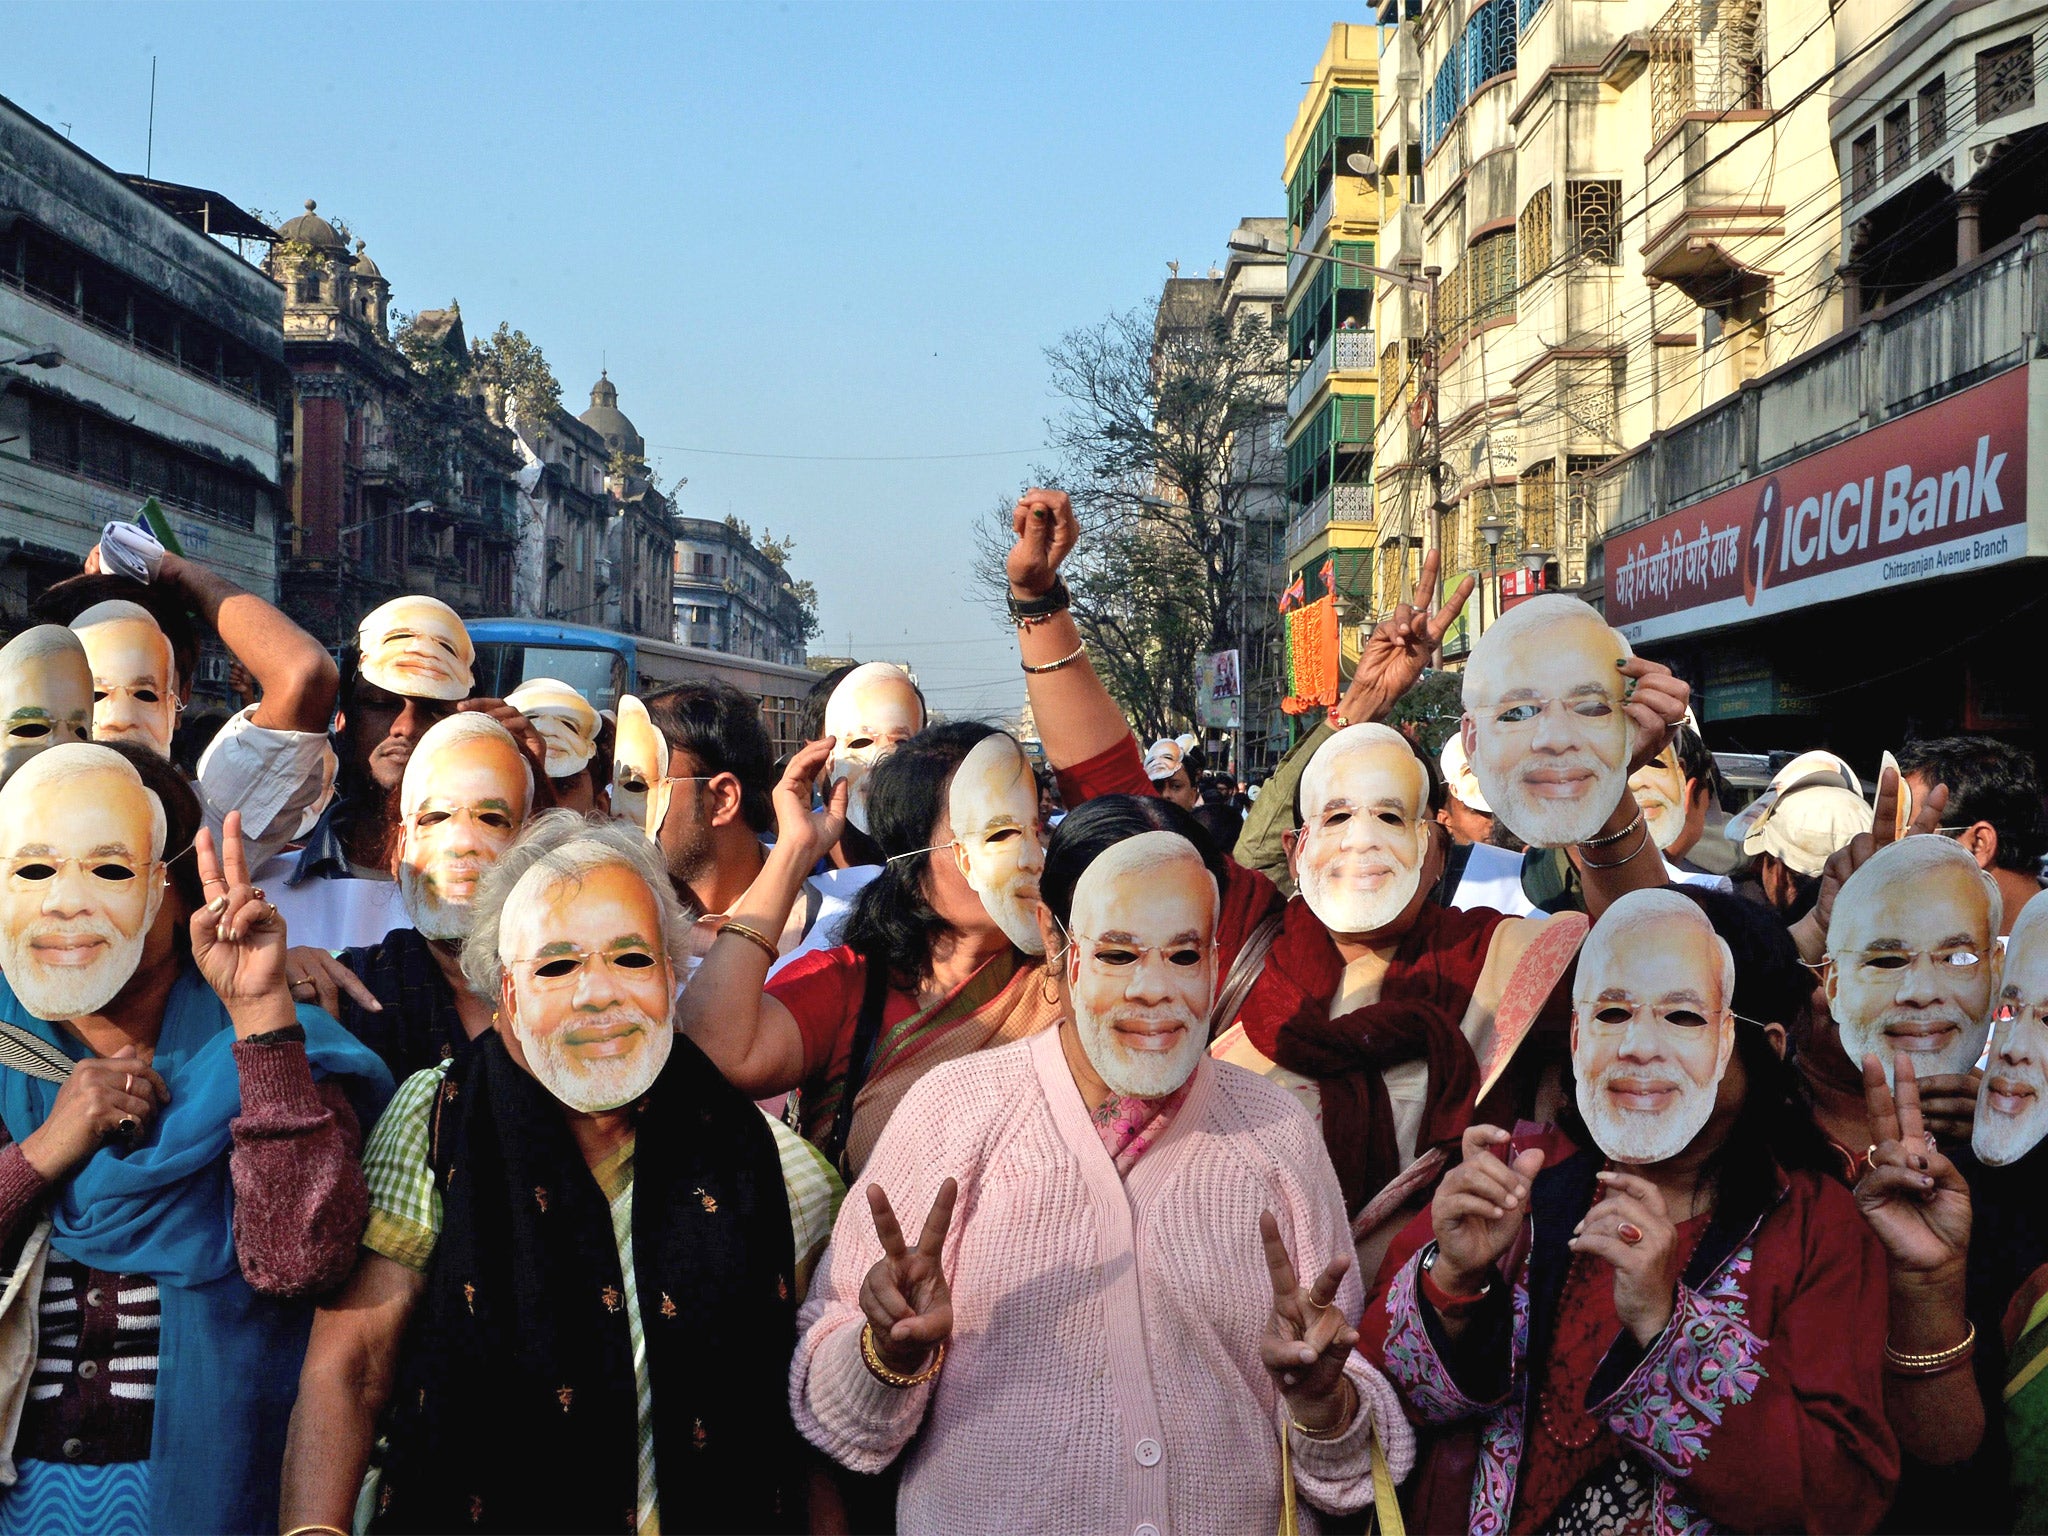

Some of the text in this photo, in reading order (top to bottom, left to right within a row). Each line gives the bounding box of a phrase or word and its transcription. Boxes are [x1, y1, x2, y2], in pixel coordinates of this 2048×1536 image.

[1780, 476, 1874, 572] ICICI
[1878, 434, 2008, 544] Bank
[1883, 534, 2008, 580] Chittaranjan Avenue Branch
